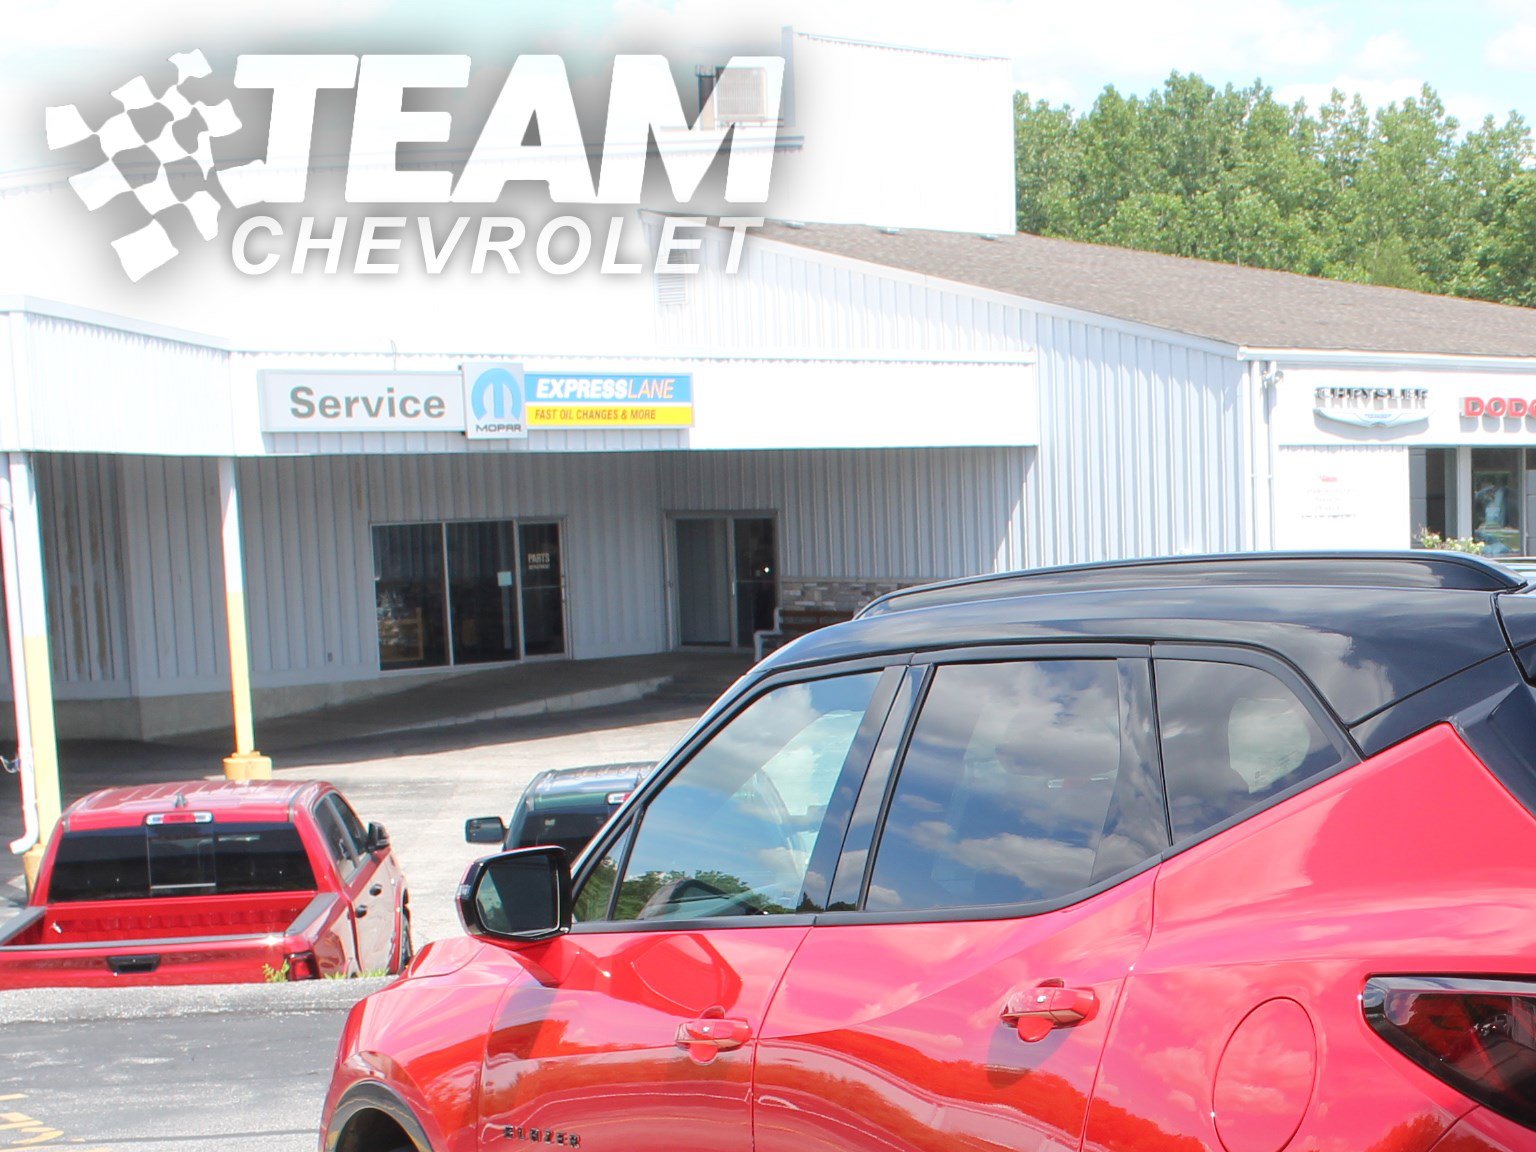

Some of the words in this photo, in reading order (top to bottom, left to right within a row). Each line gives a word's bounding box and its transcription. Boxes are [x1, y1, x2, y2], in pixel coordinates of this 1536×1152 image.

[290, 386, 446, 419] Service
[534, 408, 556, 420] FAST
[559, 409, 574, 420] OIL
[576, 409, 618, 420] CHANGES
[620, 410, 628, 420] &
[630, 409, 656, 420] MORE
[475, 423, 522, 433] MOPAR
